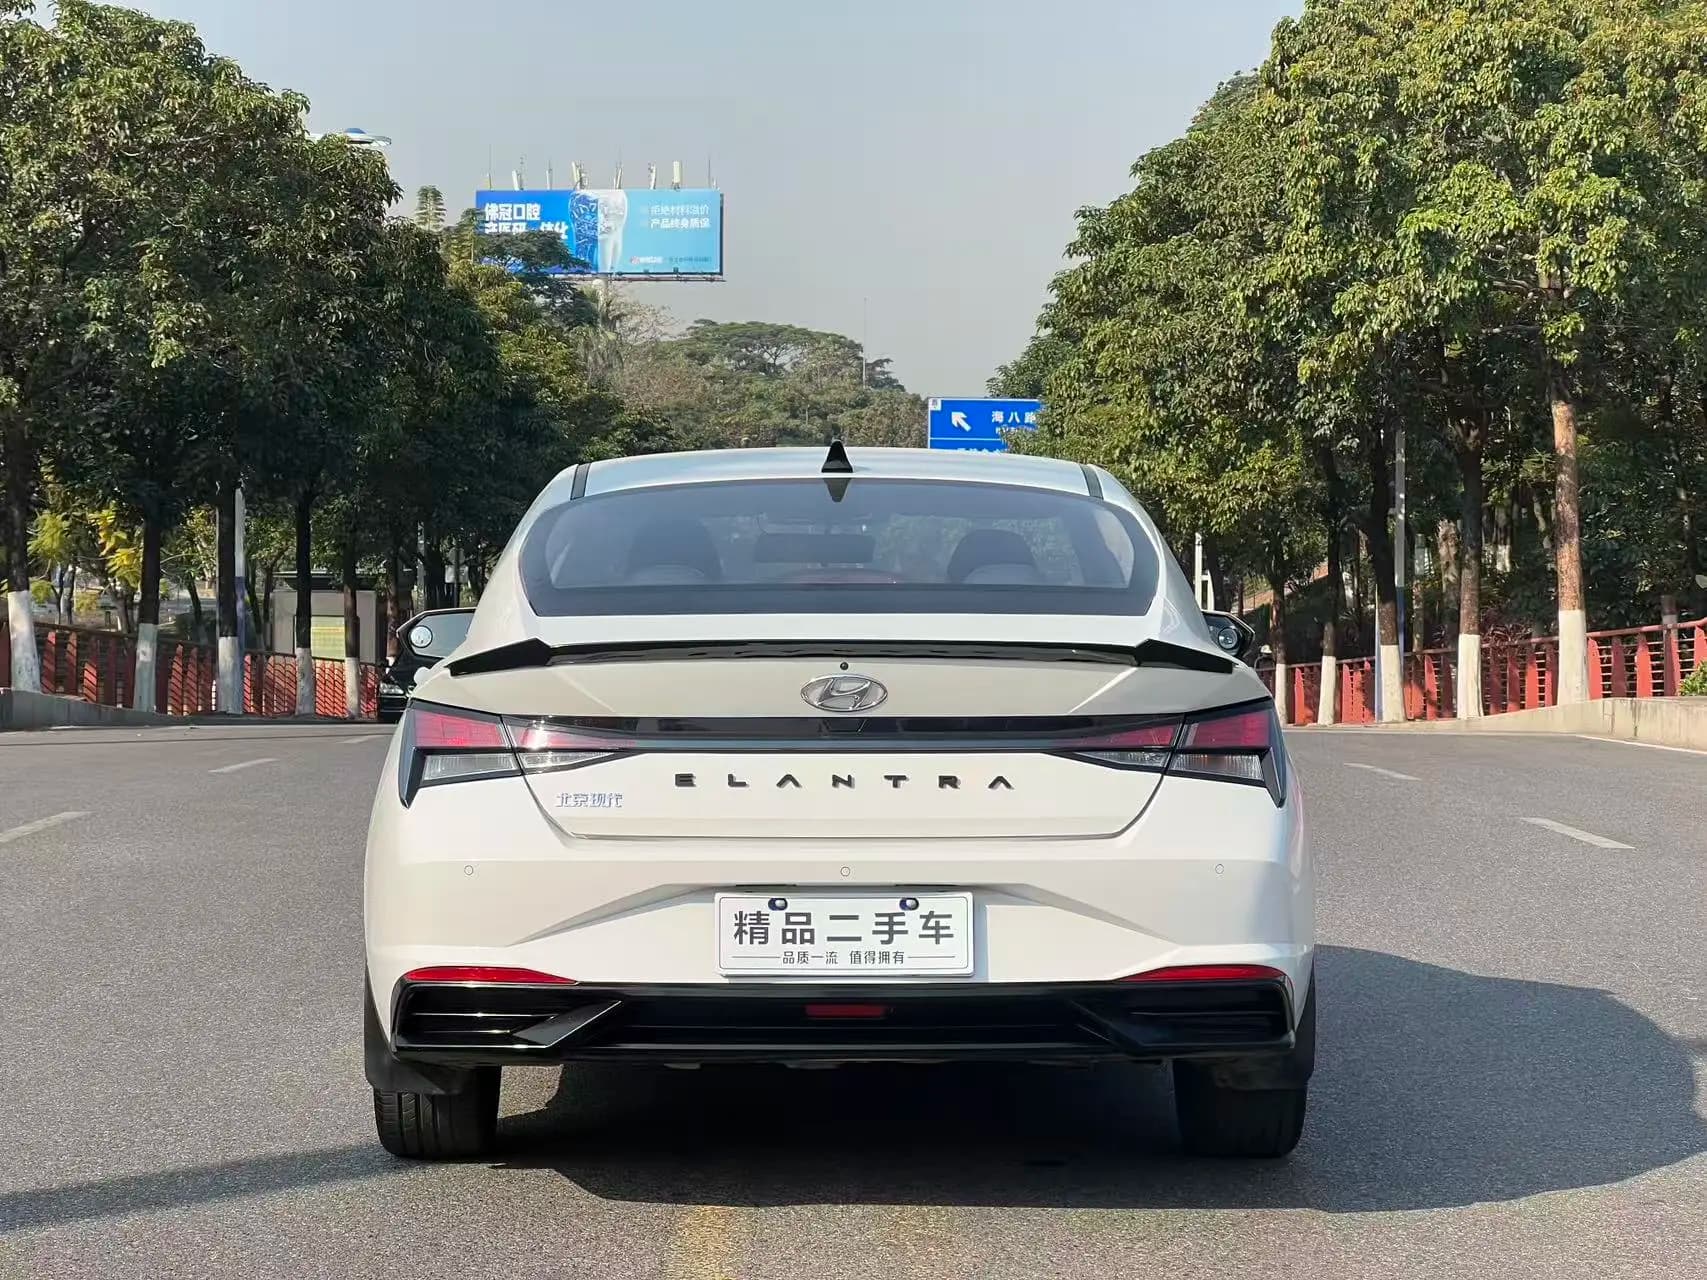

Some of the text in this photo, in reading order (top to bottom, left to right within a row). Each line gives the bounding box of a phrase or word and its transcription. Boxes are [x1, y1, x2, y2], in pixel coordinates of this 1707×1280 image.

[485, 203, 540, 221] 佛冠口腔
[650, 217, 711, 230] 产品终身质保
[992, 411, 1037, 424] 海八路
[674, 773, 1014, 789] ELANTRA
[556, 792, 623, 808] 北京现代
[733, 910, 955, 945] 精品二手车
[782, 950, 905, 965] 品质一流 值得拥有
